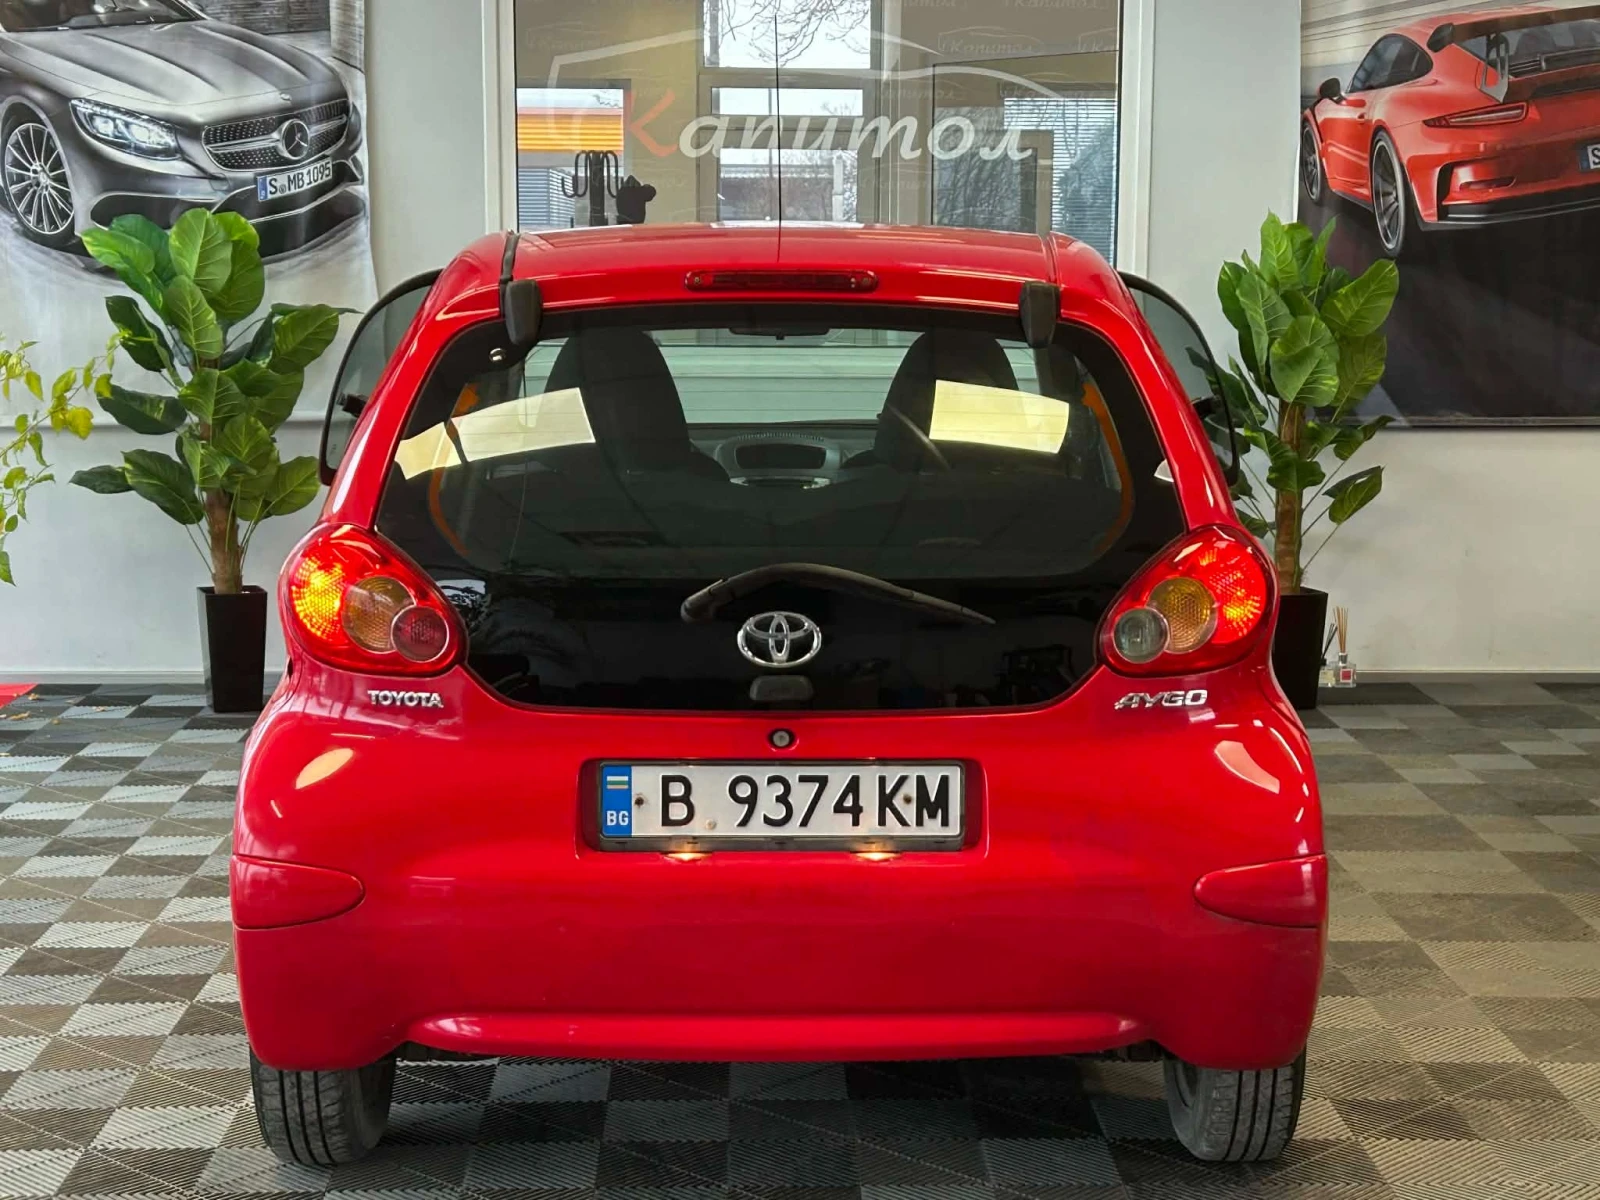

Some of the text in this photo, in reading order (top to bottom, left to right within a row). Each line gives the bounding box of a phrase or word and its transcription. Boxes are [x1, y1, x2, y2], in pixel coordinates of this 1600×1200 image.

[626, 89, 1032, 161] Капитол
[367, 689, 444, 708] TOYOTA
[1114, 689, 1208, 710] AYGO
[660, 774, 695, 828] B
[606, 810, 629, 826] BG
